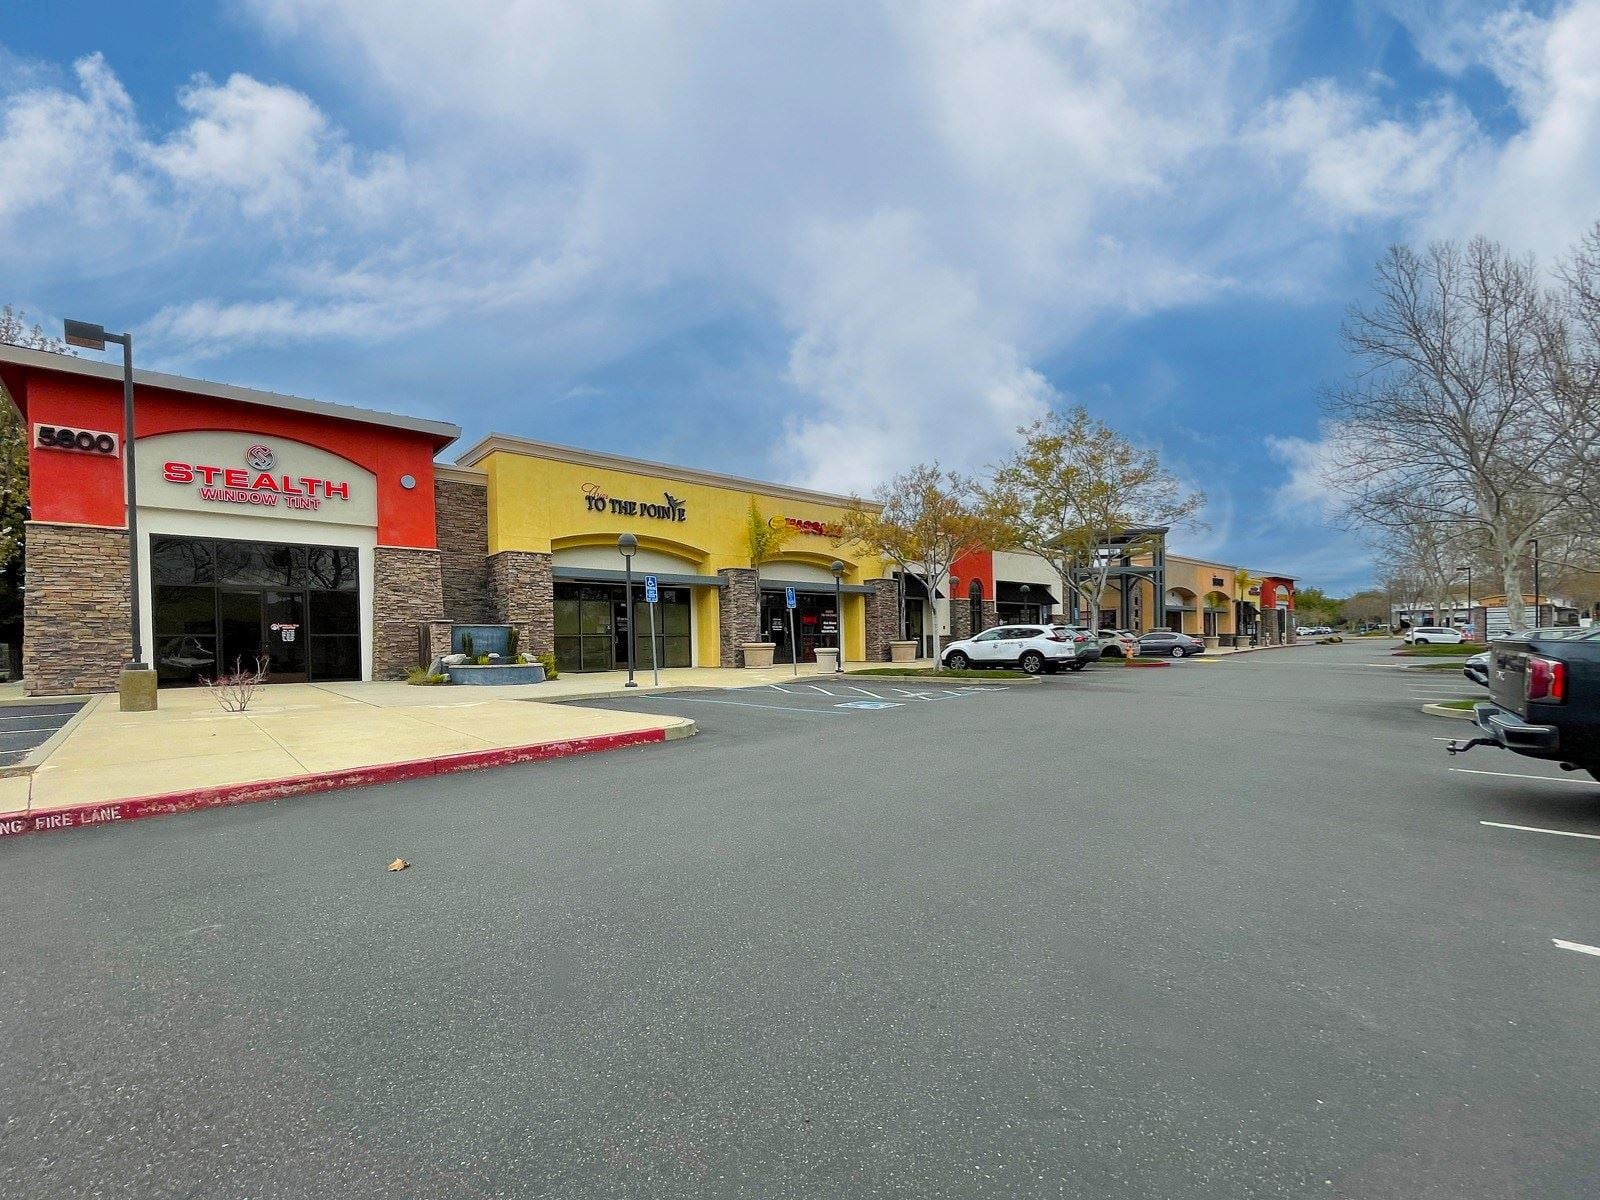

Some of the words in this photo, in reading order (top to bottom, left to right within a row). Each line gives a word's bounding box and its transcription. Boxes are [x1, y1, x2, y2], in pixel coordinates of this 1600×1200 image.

[38, 426, 114, 453] 5800
[163, 461, 349, 500] STEALTH
[199, 488, 278, 506] WINDOW
[285, 495, 321, 510] TINT
[585, 494, 607, 512] TO
[609, 497, 638, 516] THE
[35, 813, 73, 830] FIRE
[80, 806, 122, 824] LANE
